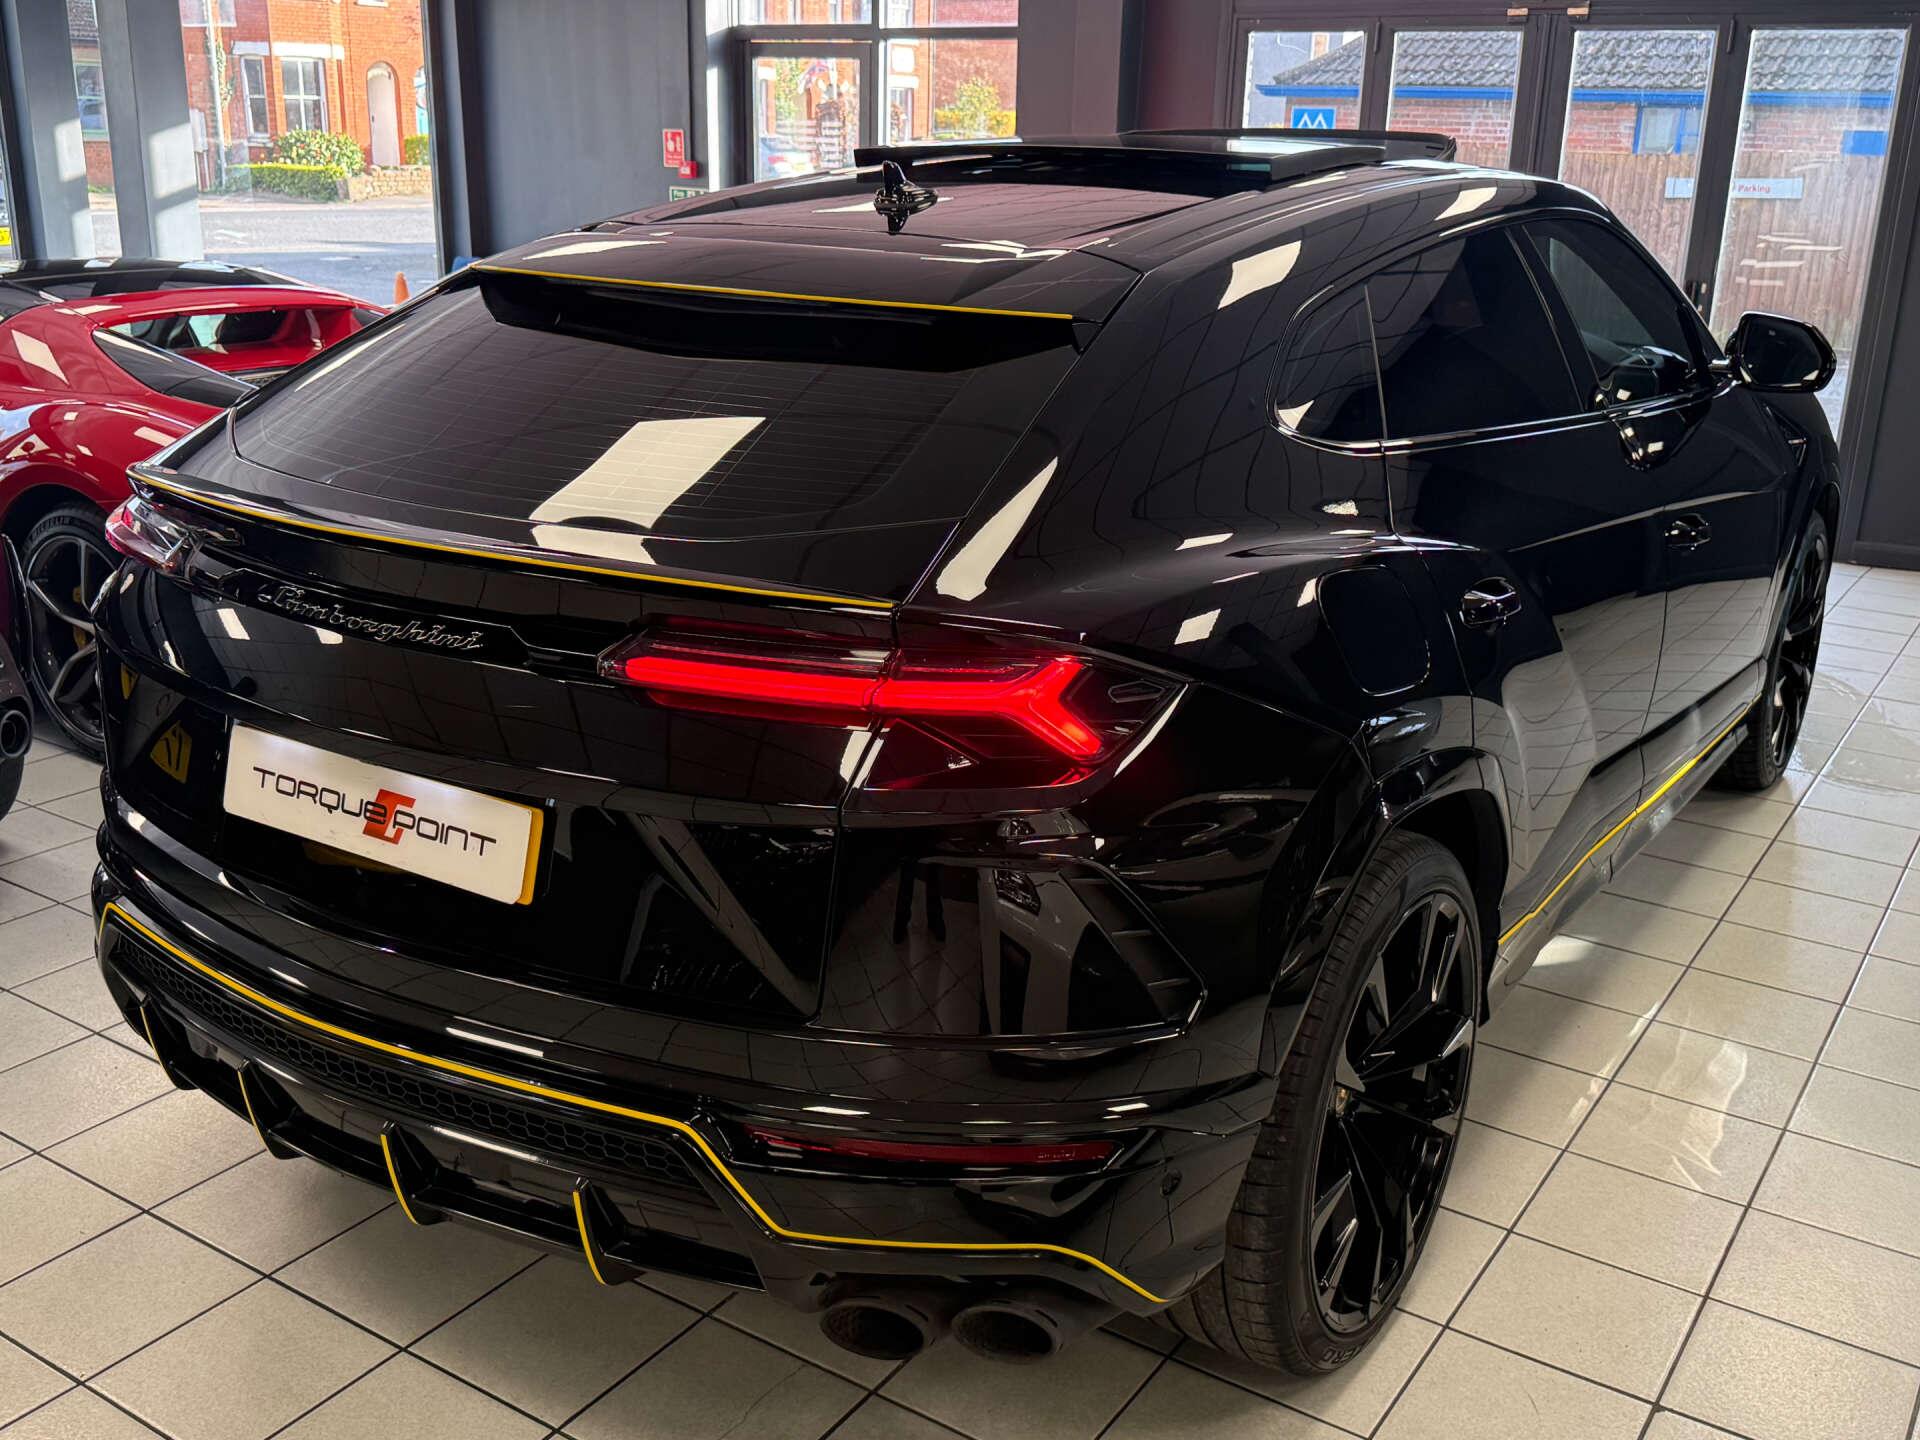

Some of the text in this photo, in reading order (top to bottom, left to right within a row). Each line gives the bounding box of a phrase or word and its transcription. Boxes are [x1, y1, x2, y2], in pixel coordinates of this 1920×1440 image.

[1738, 184, 1771, 194] Parking
[256, 583, 484, 650] Lamborghini
[252, 765, 497, 857] TORQUE POINT
